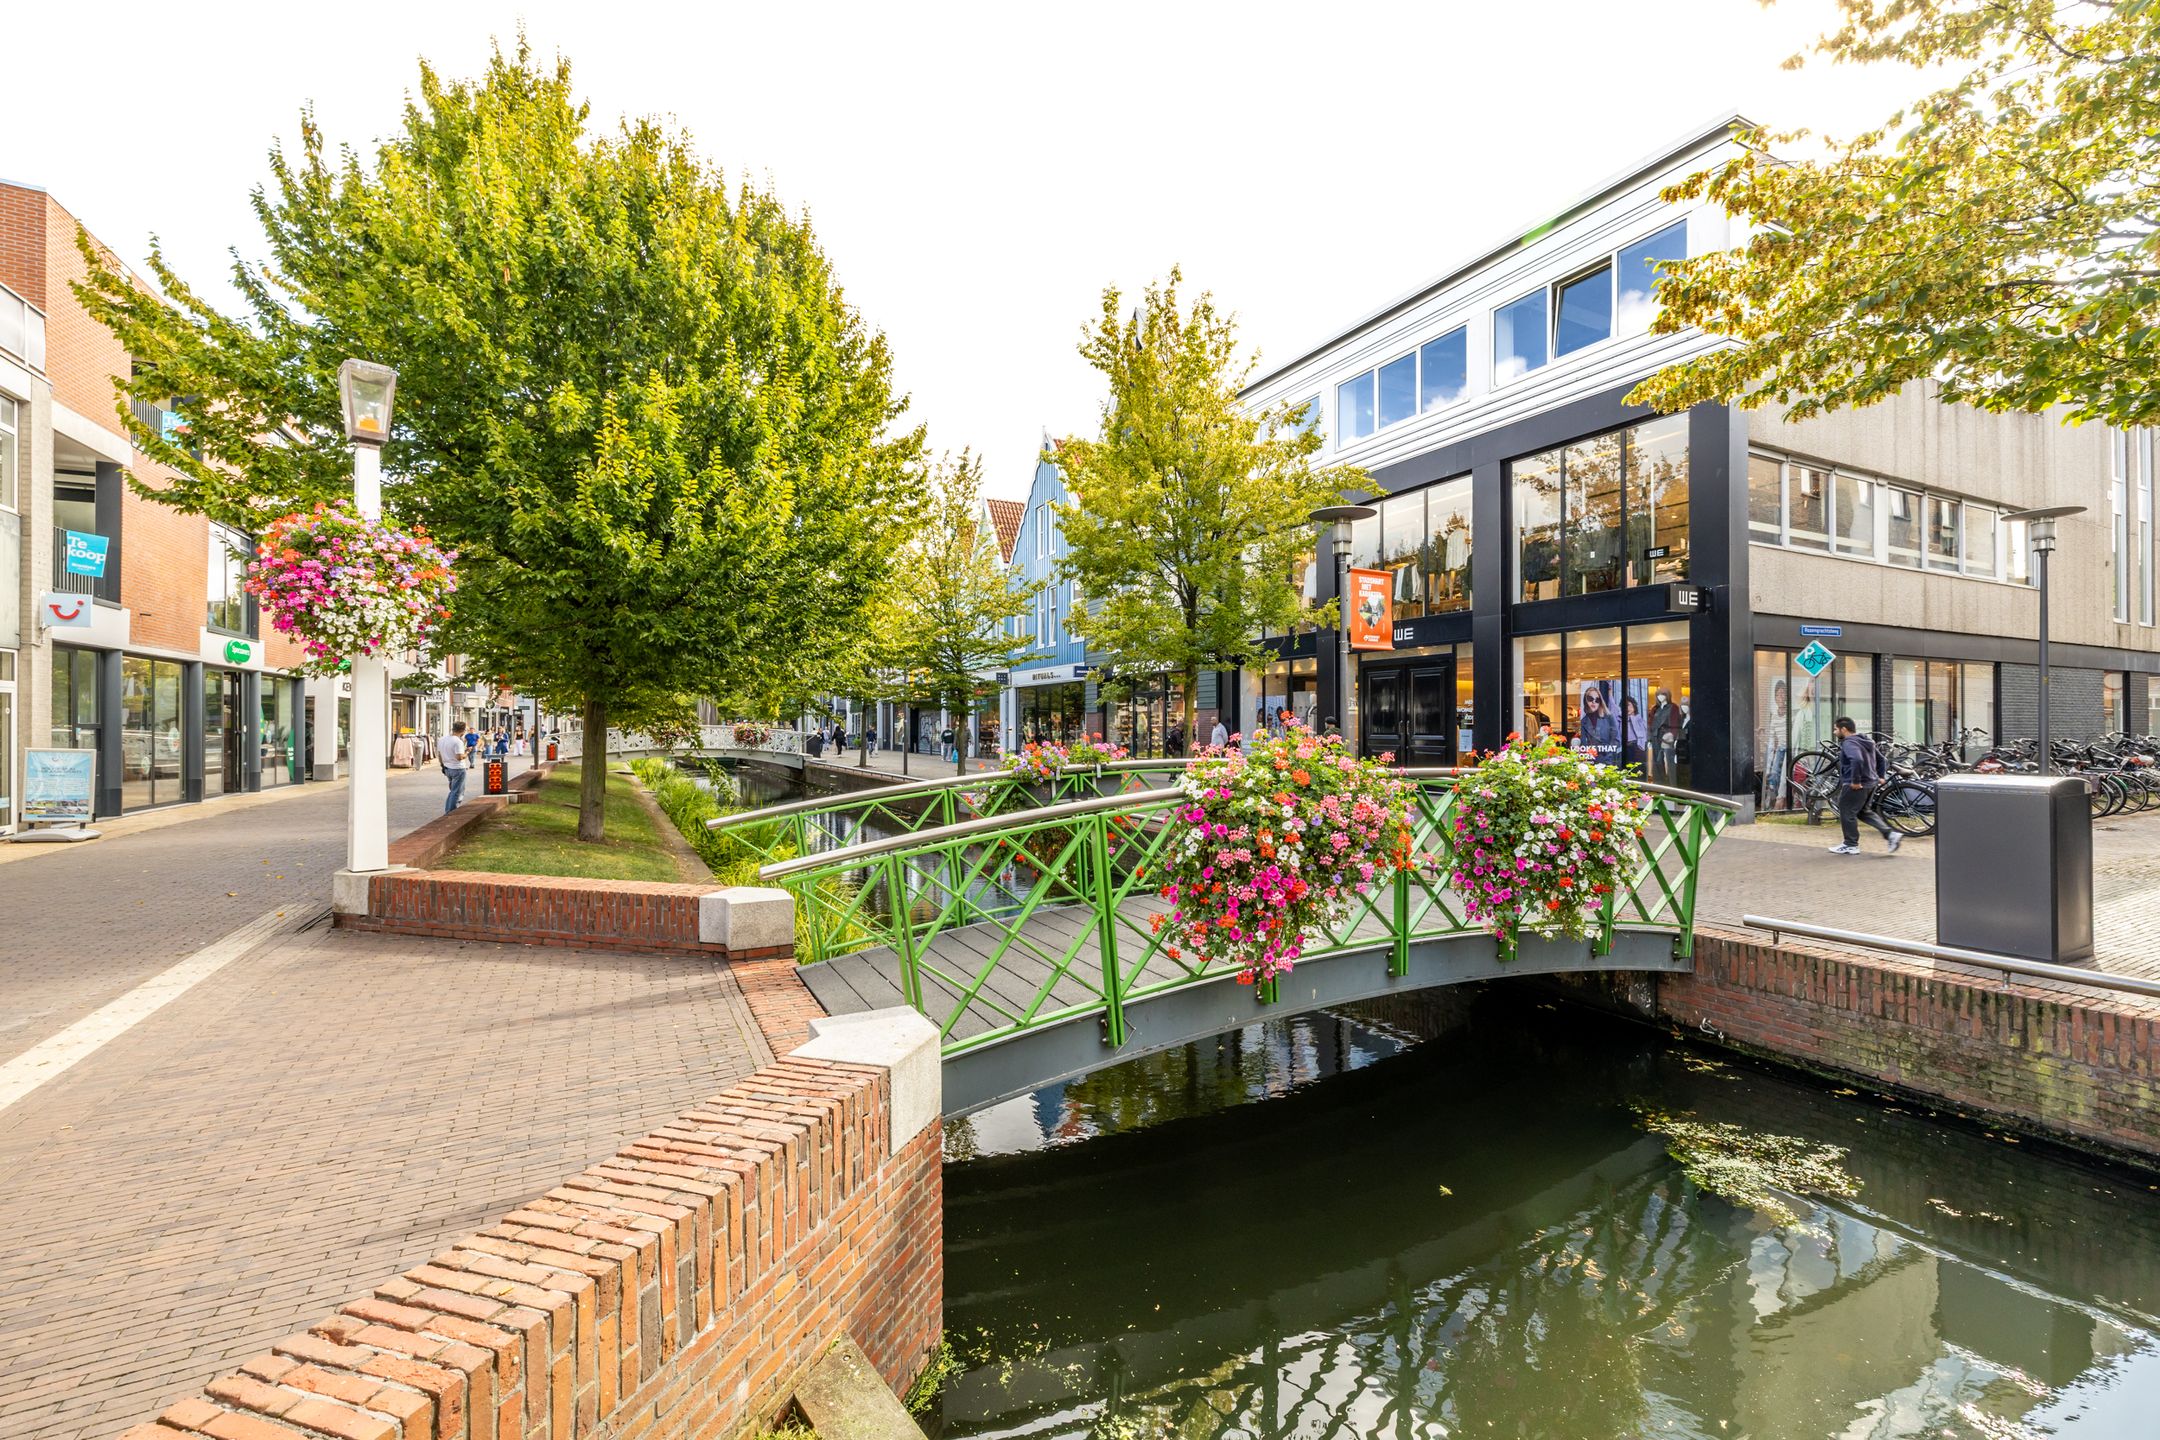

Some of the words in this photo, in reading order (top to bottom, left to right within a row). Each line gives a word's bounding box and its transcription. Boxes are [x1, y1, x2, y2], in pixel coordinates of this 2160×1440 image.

[67, 535, 88, 550] Te
[67, 544, 107, 565] koop
[1649, 548, 1665, 558] WE
[1678, 590, 1699, 606] WE
[1393, 627, 1415, 641] WE
[1804, 646, 1816, 660] P
[1597, 745, 1618, 753] THAT
